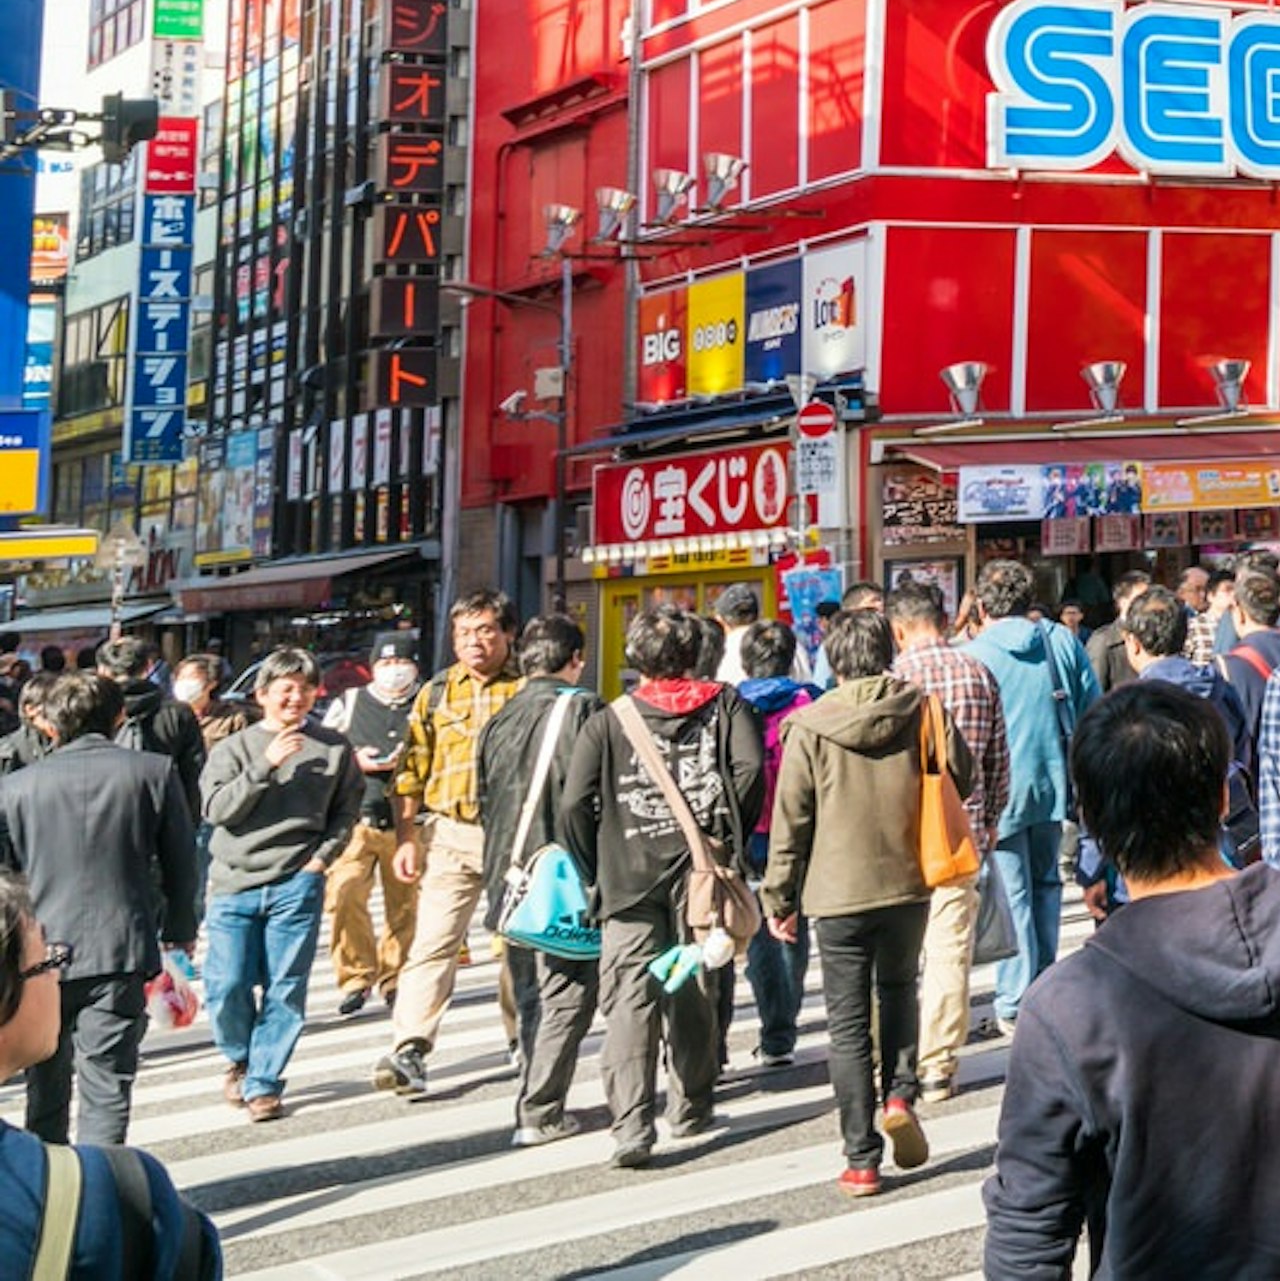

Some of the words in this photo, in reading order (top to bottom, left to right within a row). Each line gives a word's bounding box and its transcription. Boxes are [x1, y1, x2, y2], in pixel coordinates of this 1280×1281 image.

[140, 196, 187, 438] ホビーステーション
[643, 328, 682, 366] BIG
[654, 456, 749, 536] 宝くじ
[543, 922, 601, 947] adida
